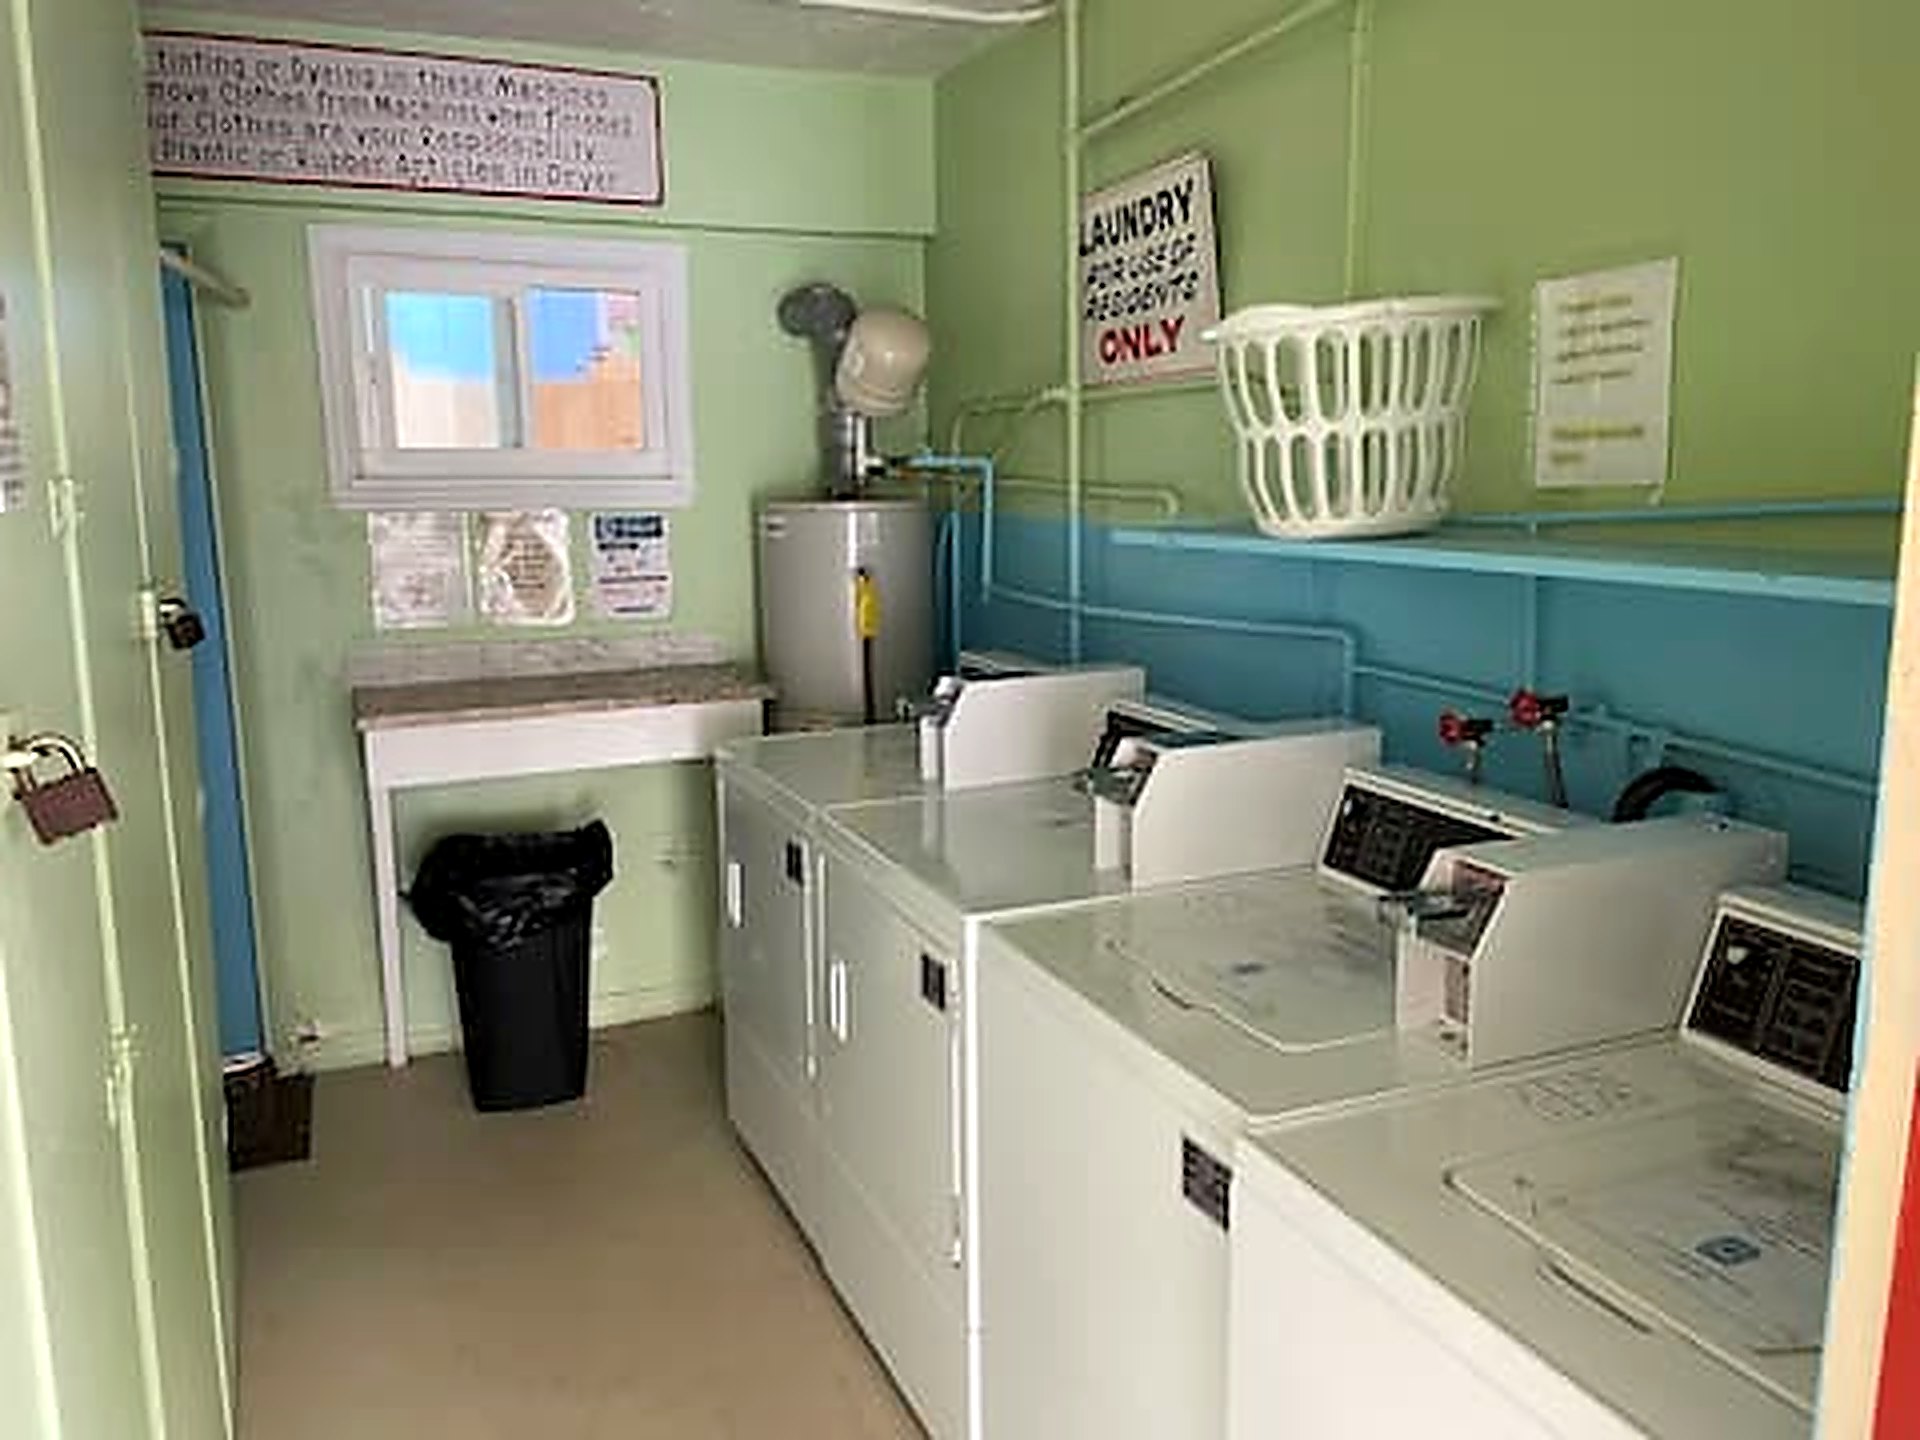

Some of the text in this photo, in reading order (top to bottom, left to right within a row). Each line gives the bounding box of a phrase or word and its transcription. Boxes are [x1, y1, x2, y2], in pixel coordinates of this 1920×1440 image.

[218, 82, 308, 110] Clothes
[317, 89, 371, 115] from
[374, 96, 479, 125] Machines
[291, 57, 375, 92] Dyeing
[416, 70, 491, 97] these
[496, 76, 608, 108] Machines
[195, 109, 299, 141] Clothes
[304, 121, 344, 143] are
[356, 123, 409, 150] your
[420, 122, 597, 163] Responsibility
[162, 136, 249, 166] Plastic
[297, 147, 387, 177] Rubber
[397, 153, 505, 186] Articles
[514, 163, 538, 186] in
[547, 163, 619, 195] Dryer
[1079, 177, 1194, 257] LAUNDRY
[1087, 233, 1196, 289] FOR USE OF
[1086, 271, 1199, 321] RESIDENTS
[1100, 314, 1185, 364] ONLY
